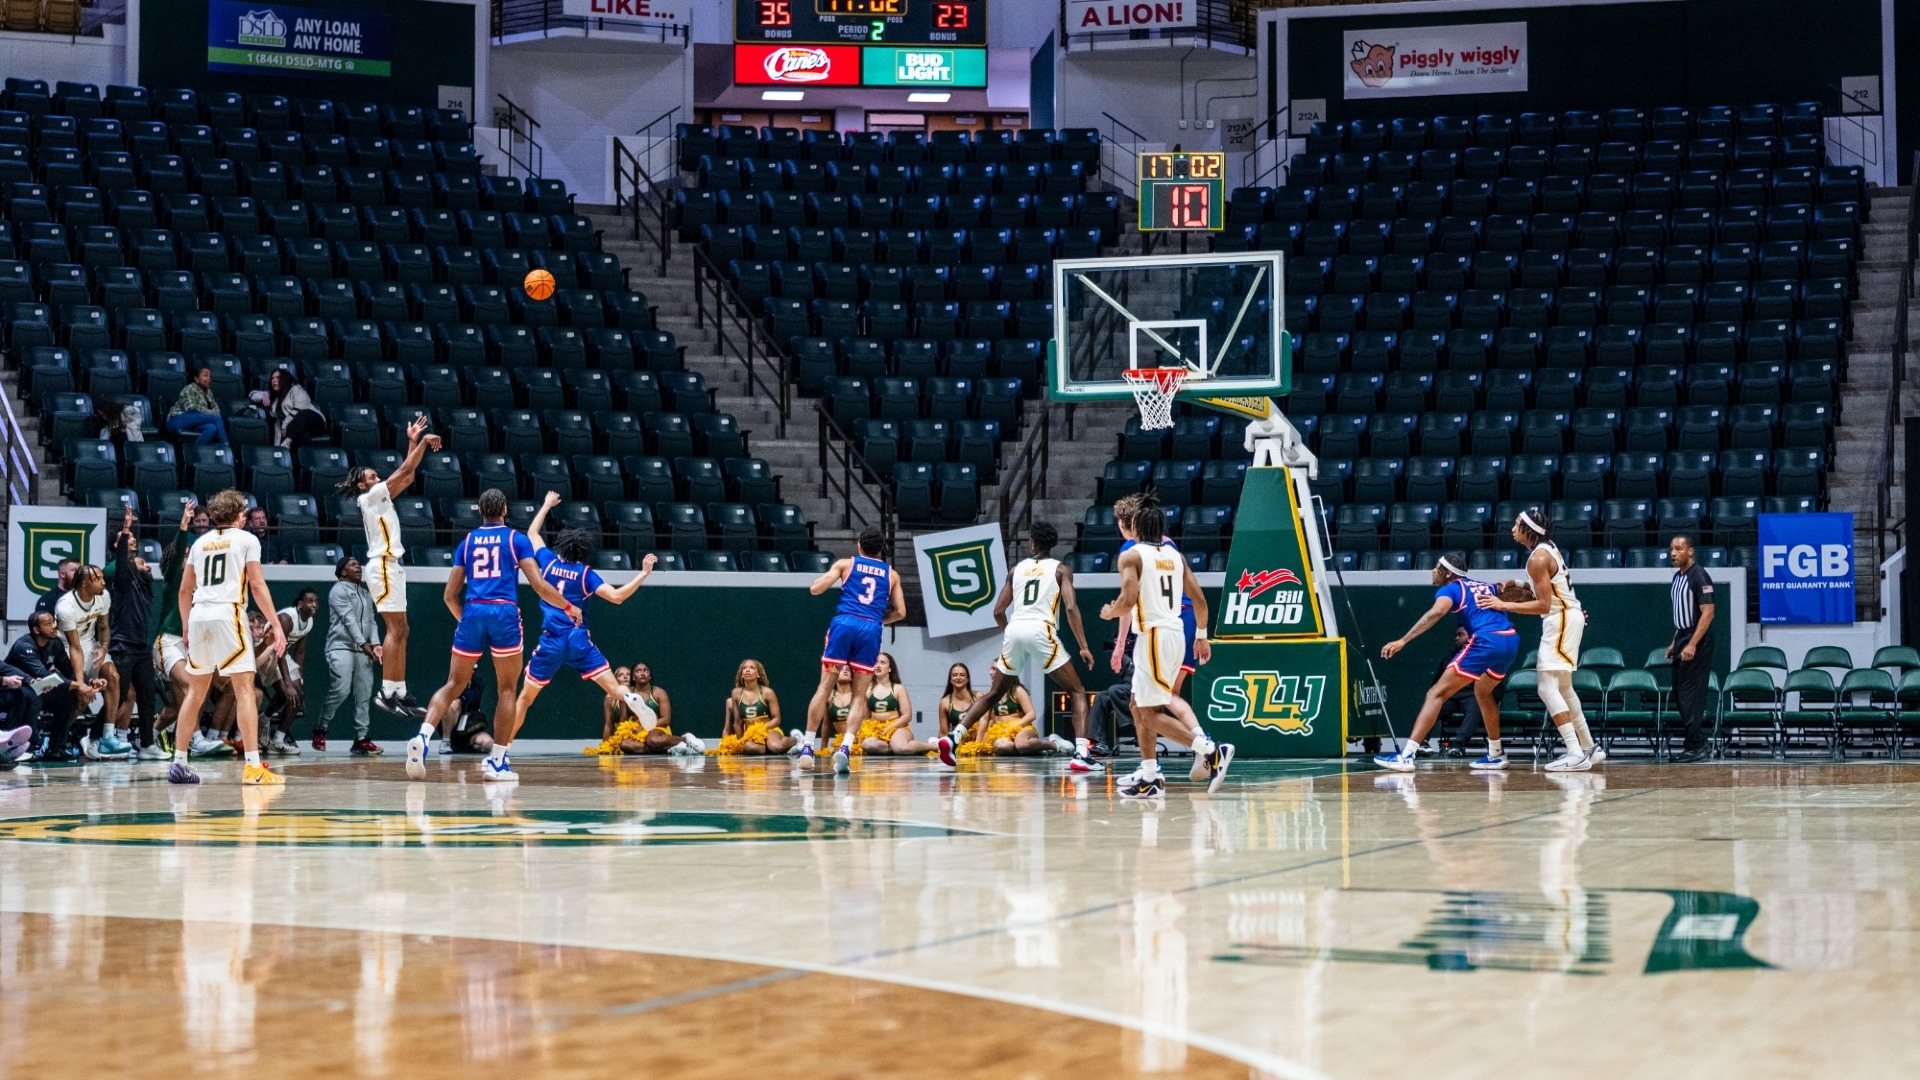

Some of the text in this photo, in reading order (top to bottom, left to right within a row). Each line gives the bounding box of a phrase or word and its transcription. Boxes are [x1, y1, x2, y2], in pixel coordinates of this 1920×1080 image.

[590, 0, 675, 19] LIKE...
[760, 1, 791, 25] 35
[937, 4, 968, 28] 23
[1081, 2, 1183, 27] A LION!
[819, 15, 836, 23] POSS
[886, 16, 903, 24] POSS
[239, 19, 287, 38] DSLD
[295, 18, 363, 38] ANY LOAN.
[764, 30, 792, 38] BONUS
[838, 21, 885, 41] PERIOD 2
[929, 32, 957, 41] BONUS
[293, 35, 363, 54] ANY HOME.
[247, 53, 342, 70] 1 (844) DSLD-MTG
[905, 53, 944, 67] BUD
[1400, 45, 1520, 69] piggly wiggly
[898, 66, 951, 80] LIGHT
[1454, 68, 1475, 76] Down
[1853, 89, 1869, 99] 212
[447, 100, 463, 108] 214
[1298, 112, 1320, 120] 212A
[1227, 124, 1247, 133] 212A
[1171, 186, 1208, 227] 10
[474, 536, 502, 545] MARA
[40, 539, 73, 579] S
[472, 546, 502, 579] 21
[1763, 544, 1850, 578] FGB
[203, 553, 226, 587] 10
[551, 565, 579, 581] BARTLEY
[856, 563, 886, 578] GREEN
[947, 557, 981, 595] S
[556, 580, 566, 596] 1
[857, 576, 877, 606] 3
[1023, 579, 1040, 606] 0
[1160, 575, 1174, 610] 4
[1829, 581, 1851, 589] BANK
[1275, 590, 1304, 604] Bill
[745, 705, 757, 718] S
